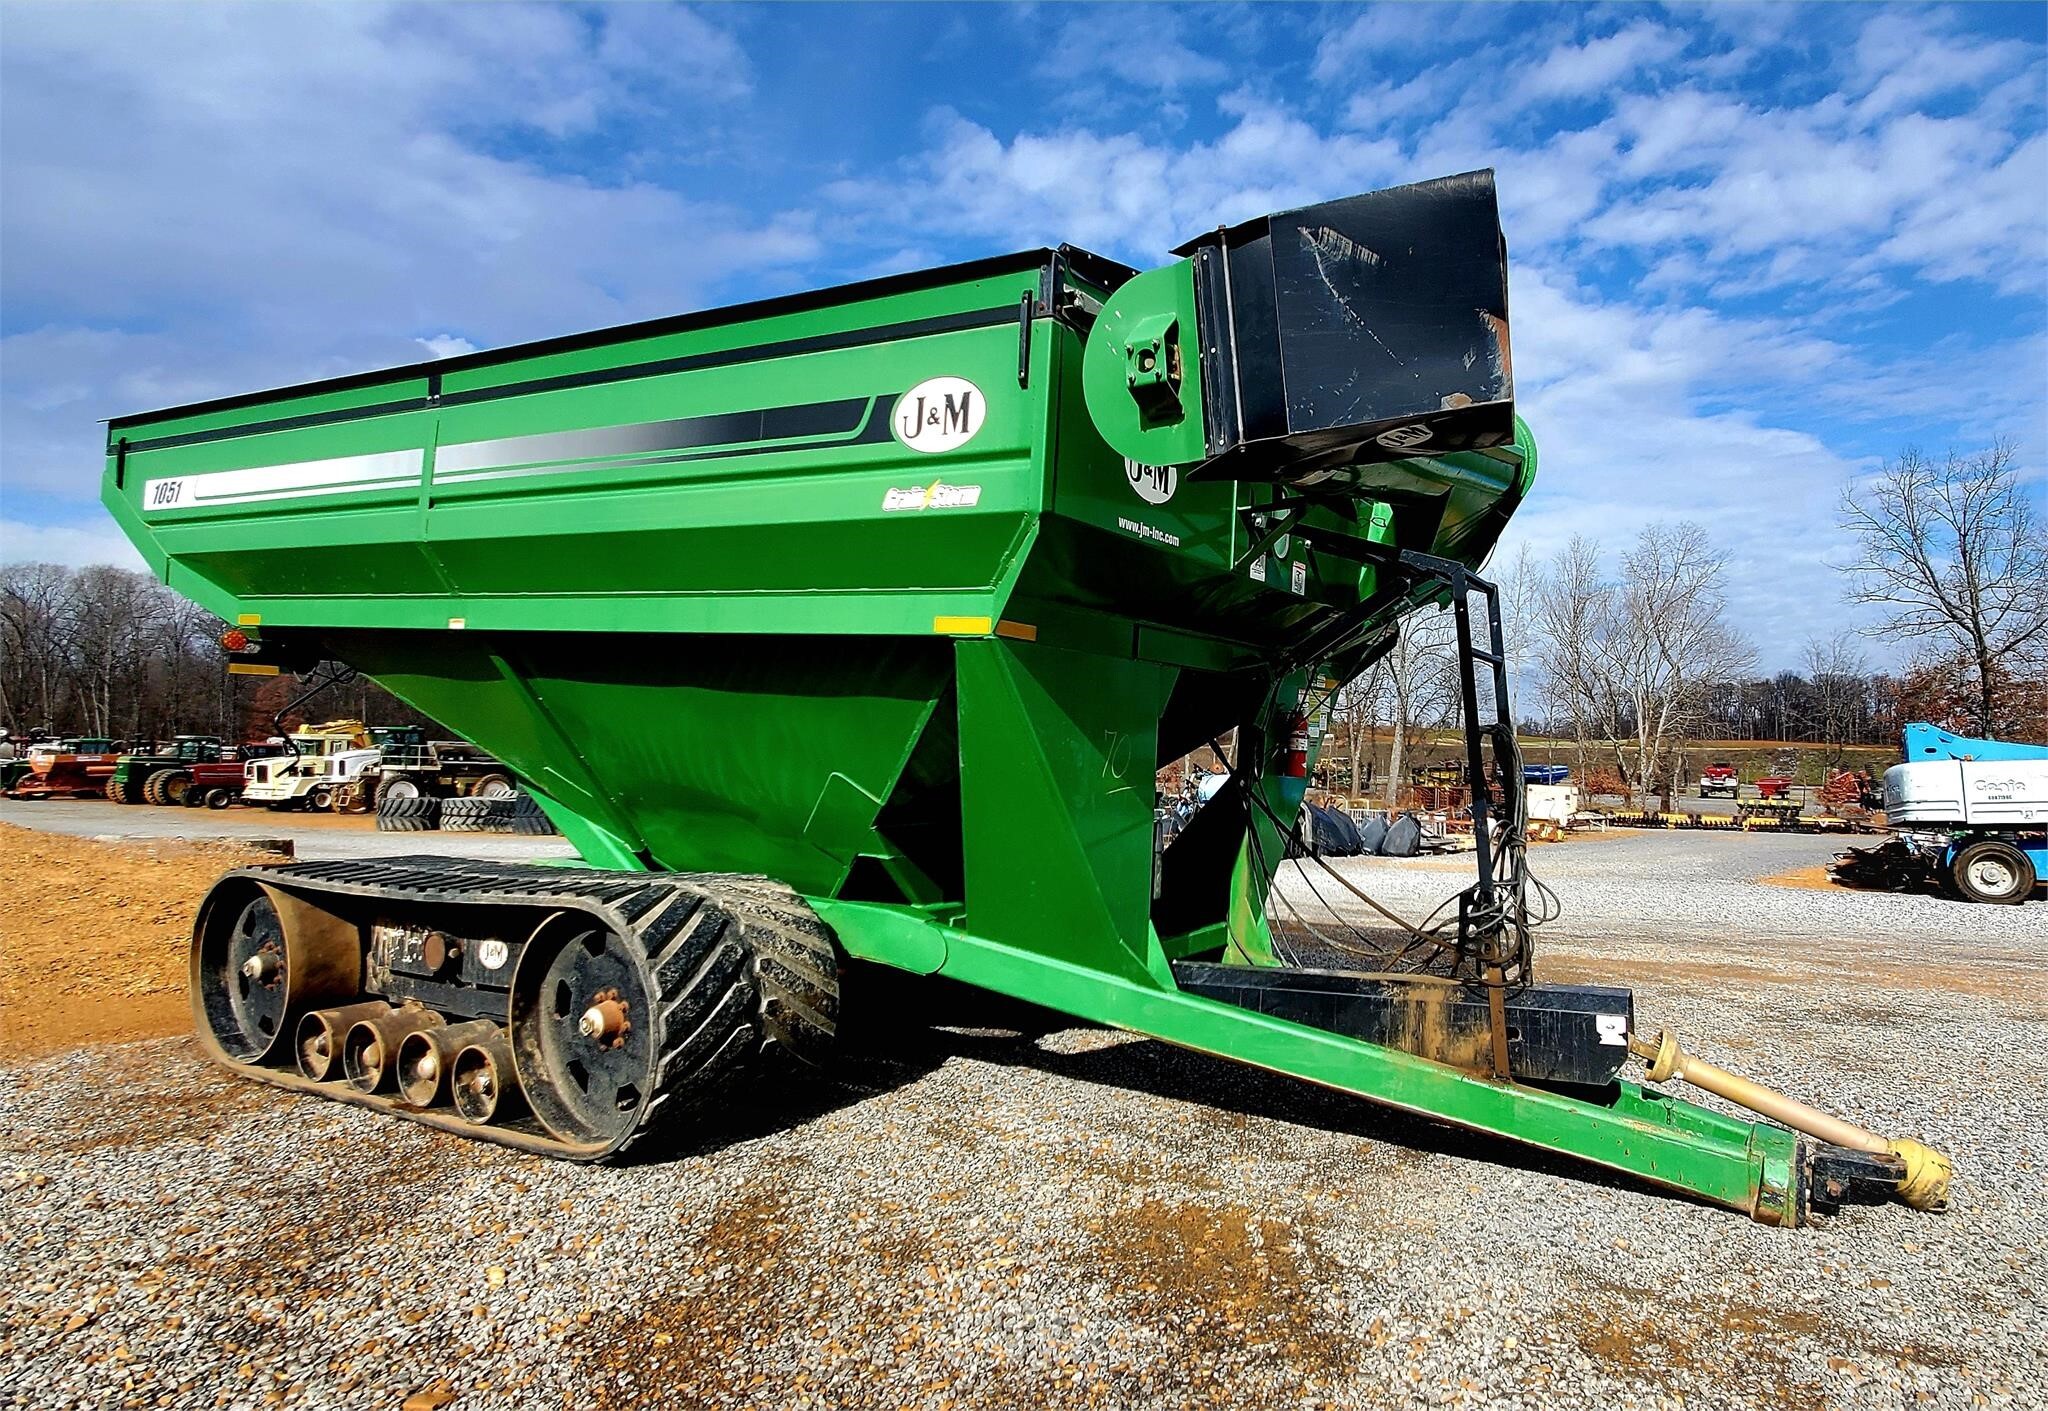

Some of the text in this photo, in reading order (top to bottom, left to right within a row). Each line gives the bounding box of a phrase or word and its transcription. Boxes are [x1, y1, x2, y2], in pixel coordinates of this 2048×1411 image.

[903, 391, 972, 439] J&M
[1381, 426, 1431, 447] J&M
[153, 481, 183, 505] 1051
[1118, 517, 1180, 547] www.jm-inc.com
